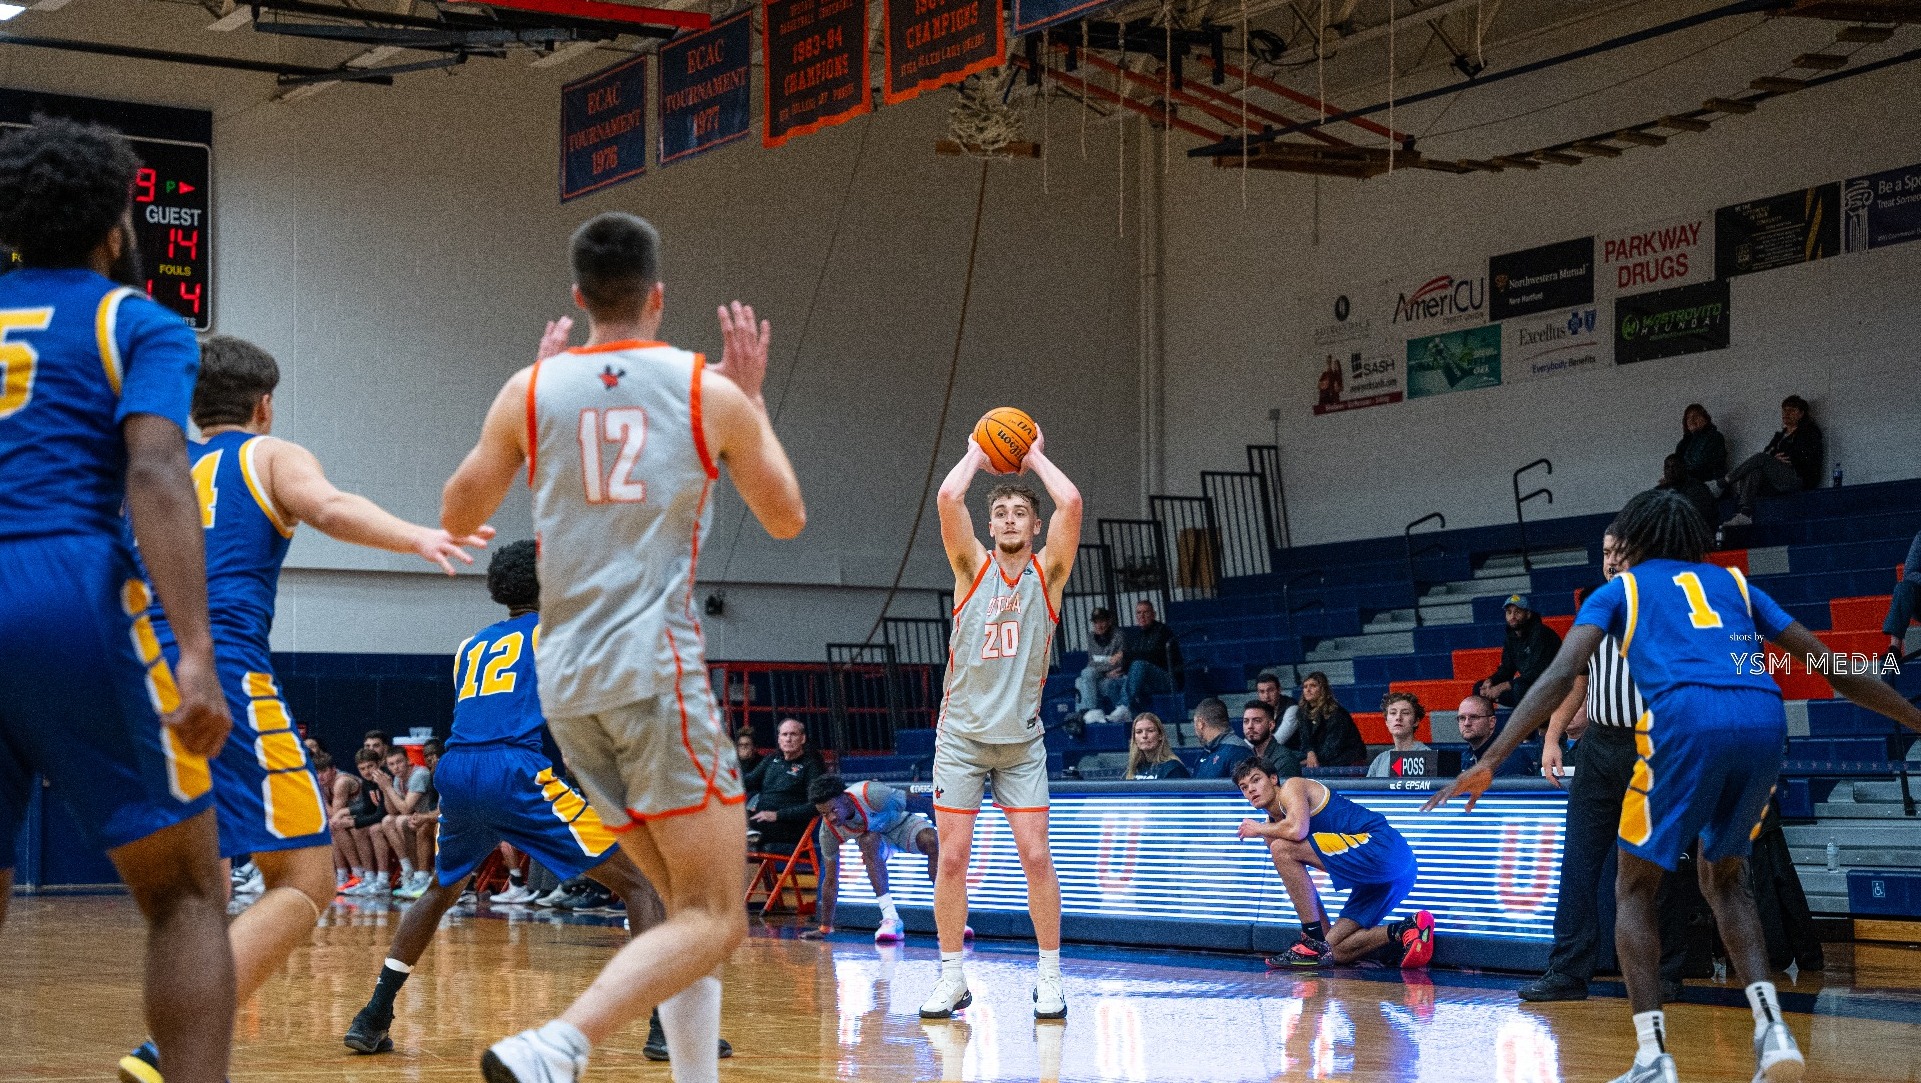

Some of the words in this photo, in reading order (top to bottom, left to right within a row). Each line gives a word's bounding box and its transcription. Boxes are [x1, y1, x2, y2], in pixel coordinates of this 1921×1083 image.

[906, 1, 979, 49] CHAMPIONS
[686, 38, 725, 75] ECAC
[792, 25, 843, 64] 1983-84
[665, 66, 748, 114] TOURNAMENT
[783, 53, 849, 96] CHAMPIONS
[587, 81, 622, 116] ECAC
[567, 107, 641, 153] TOURNAMENT
[693, 104, 720, 138] 1977
[592, 144, 618, 175] 1976
[1878, 181, 1893, 195] Be
[1895, 180, 1903, 192] a
[146, 205, 202, 226] GUEST
[168, 227, 199, 260] 14
[1604, 221, 1702, 264] PARKWAY
[158, 264, 192, 277] FOULS
[1508, 271, 1558, 290] Northwestern
[1559, 264, 1587, 280] Mutual
[1617, 253, 1689, 289] DRUGS
[179, 281, 203, 314] 4
[1392, 277, 1485, 325] AmeriCU
[1519, 322, 1567, 347] Excellus
[1639, 315, 1722, 337] HYUNDAI
[1363, 359, 1396, 377] SASH
[1531, 360, 1568, 375] Everybody
[1568, 355, 1596, 369] Benefits
[578, 406, 648, 505] 12
[1672, 570, 1724, 629] 1
[981, 620, 1020, 660] 20
[458, 631, 525, 702] 12
[1402, 757, 1425, 776] POSS
